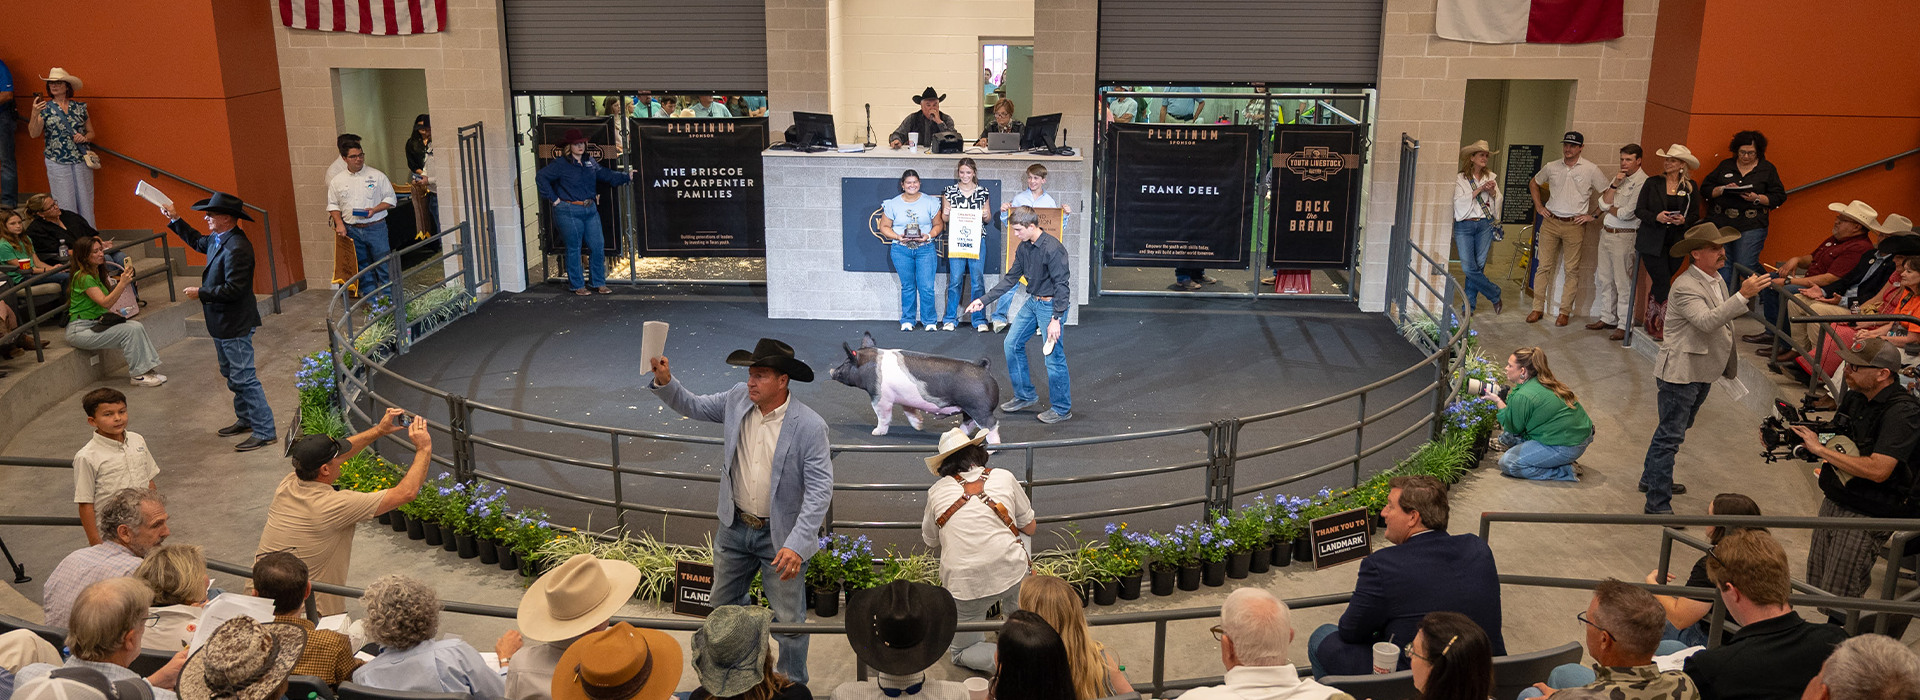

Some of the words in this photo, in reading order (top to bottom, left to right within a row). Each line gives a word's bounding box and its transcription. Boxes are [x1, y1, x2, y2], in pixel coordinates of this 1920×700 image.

[667, 122, 735, 133] PLATINUM
[1148, 128, 1218, 140] PLATINUM
[1290, 159, 1309, 167] YOUTH
[1310, 159, 1341, 167] LIVESTOCK
[663, 168, 686, 176] THE
[691, 167, 743, 176] BRISCOE
[653, 179, 679, 188] AND
[684, 178, 754, 188] CARPENTER
[676, 190, 733, 198] FAMILIES
[1141, 184, 1183, 194] FRANK
[1188, 186, 1220, 195] DEEL
[1295, 200, 1331, 212] BACK
[1289, 219, 1333, 232] BRAND
[1315, 525, 1340, 537] THANK
[1340, 522, 1355, 530] YOU
[1355, 519, 1365, 527] TO
[1321, 535, 1363, 553] LANDMARK
[680, 572, 711, 584] THANK
[684, 590, 711, 601] LAND
